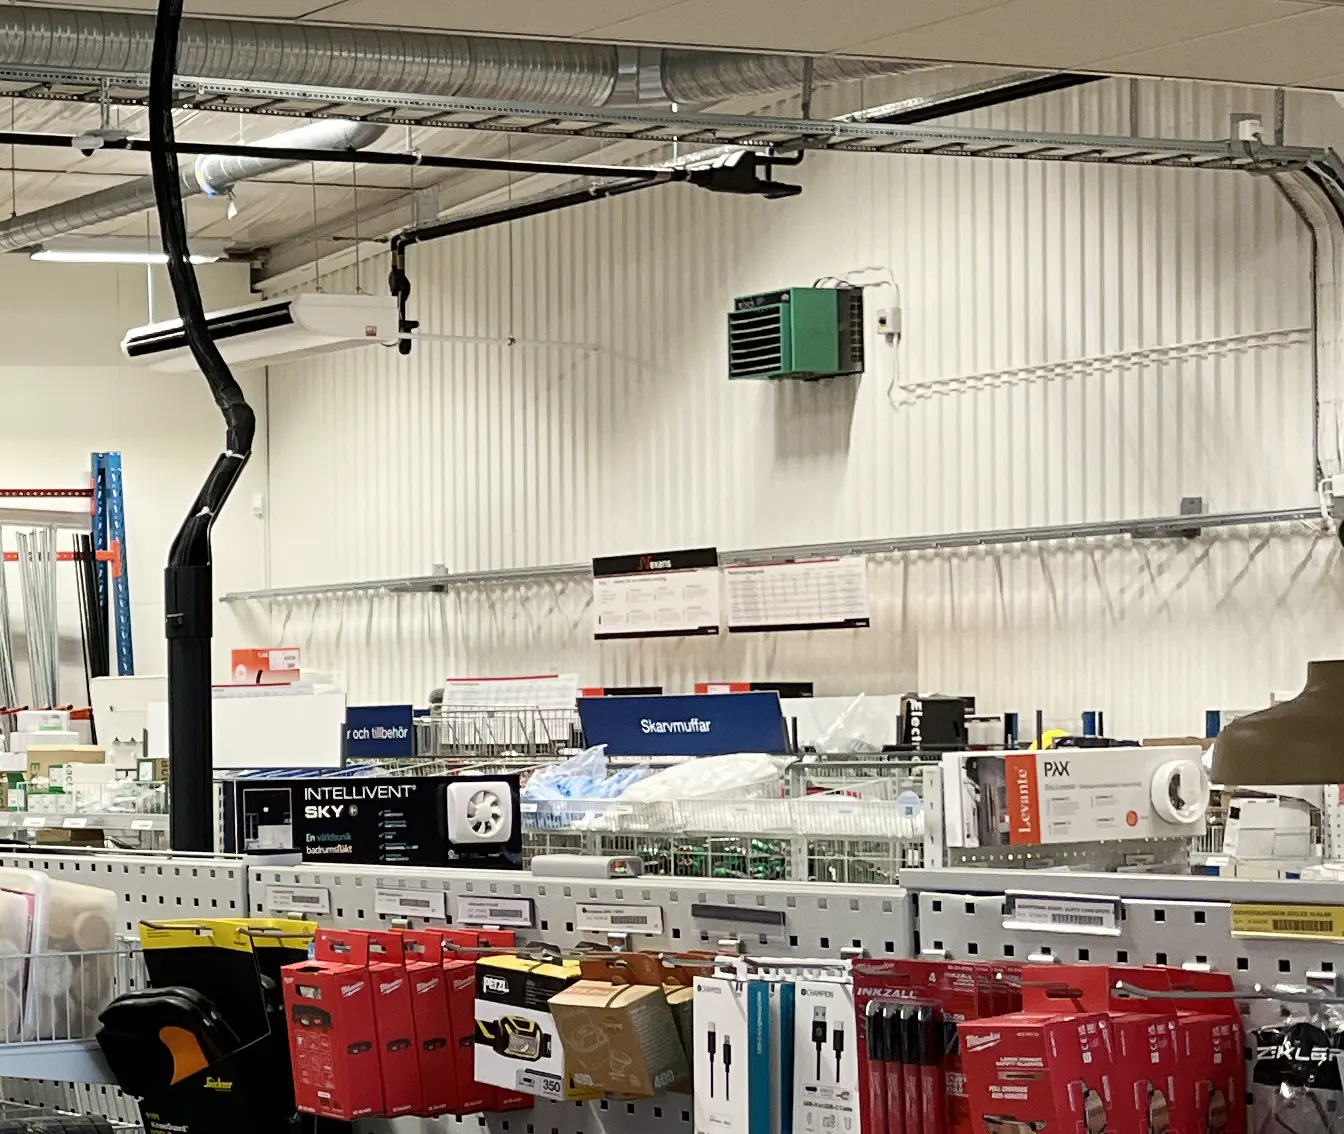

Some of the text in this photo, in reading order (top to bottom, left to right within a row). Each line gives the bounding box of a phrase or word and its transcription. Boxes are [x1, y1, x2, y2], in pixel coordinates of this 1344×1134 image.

[641, 718, 711, 735] Skarvmuffar
[1044, 761, 1071, 777] PAX
[304, 785, 413, 800] INTELLIVENT
[1018, 767, 1032, 834] Levante
[304, 805, 344, 819] SKY
[928, 972, 937, 983] 4
[857, 988, 917, 999] INKZALL
[542, 1079, 561, 1093] 350
